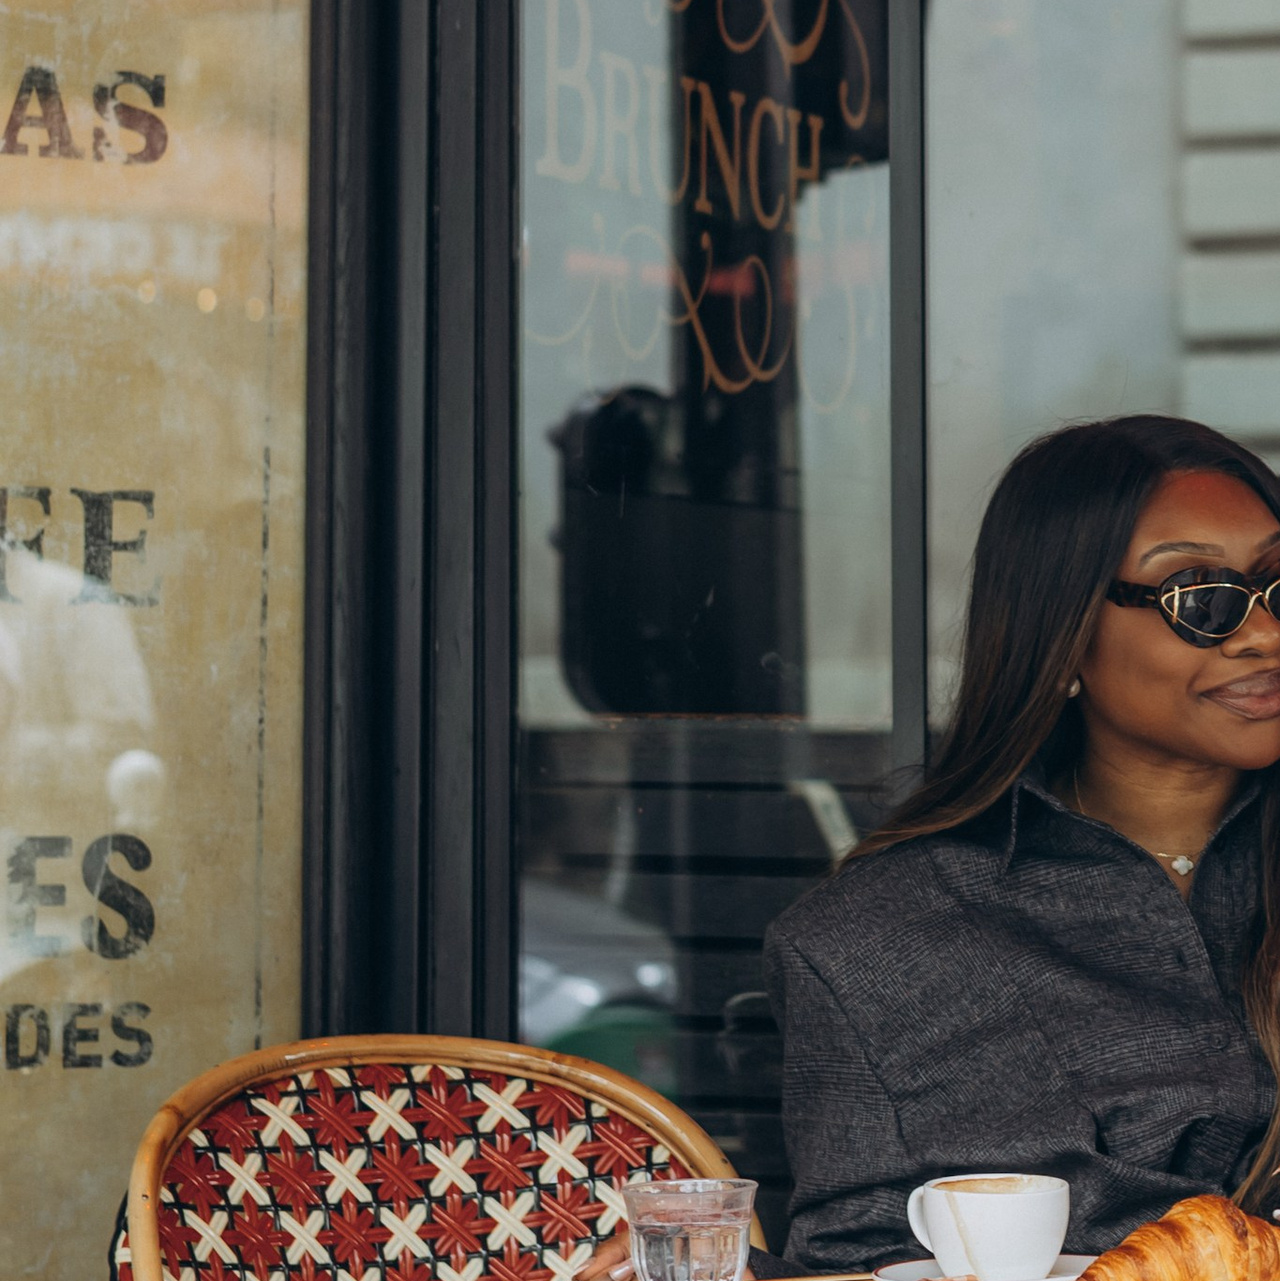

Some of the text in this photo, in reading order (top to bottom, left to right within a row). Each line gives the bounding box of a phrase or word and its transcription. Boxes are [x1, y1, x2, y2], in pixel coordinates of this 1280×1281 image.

[0, 66, 168, 164] AS
[6, 833, 155, 960] ES
[5, 1001, 154, 1070] DES
